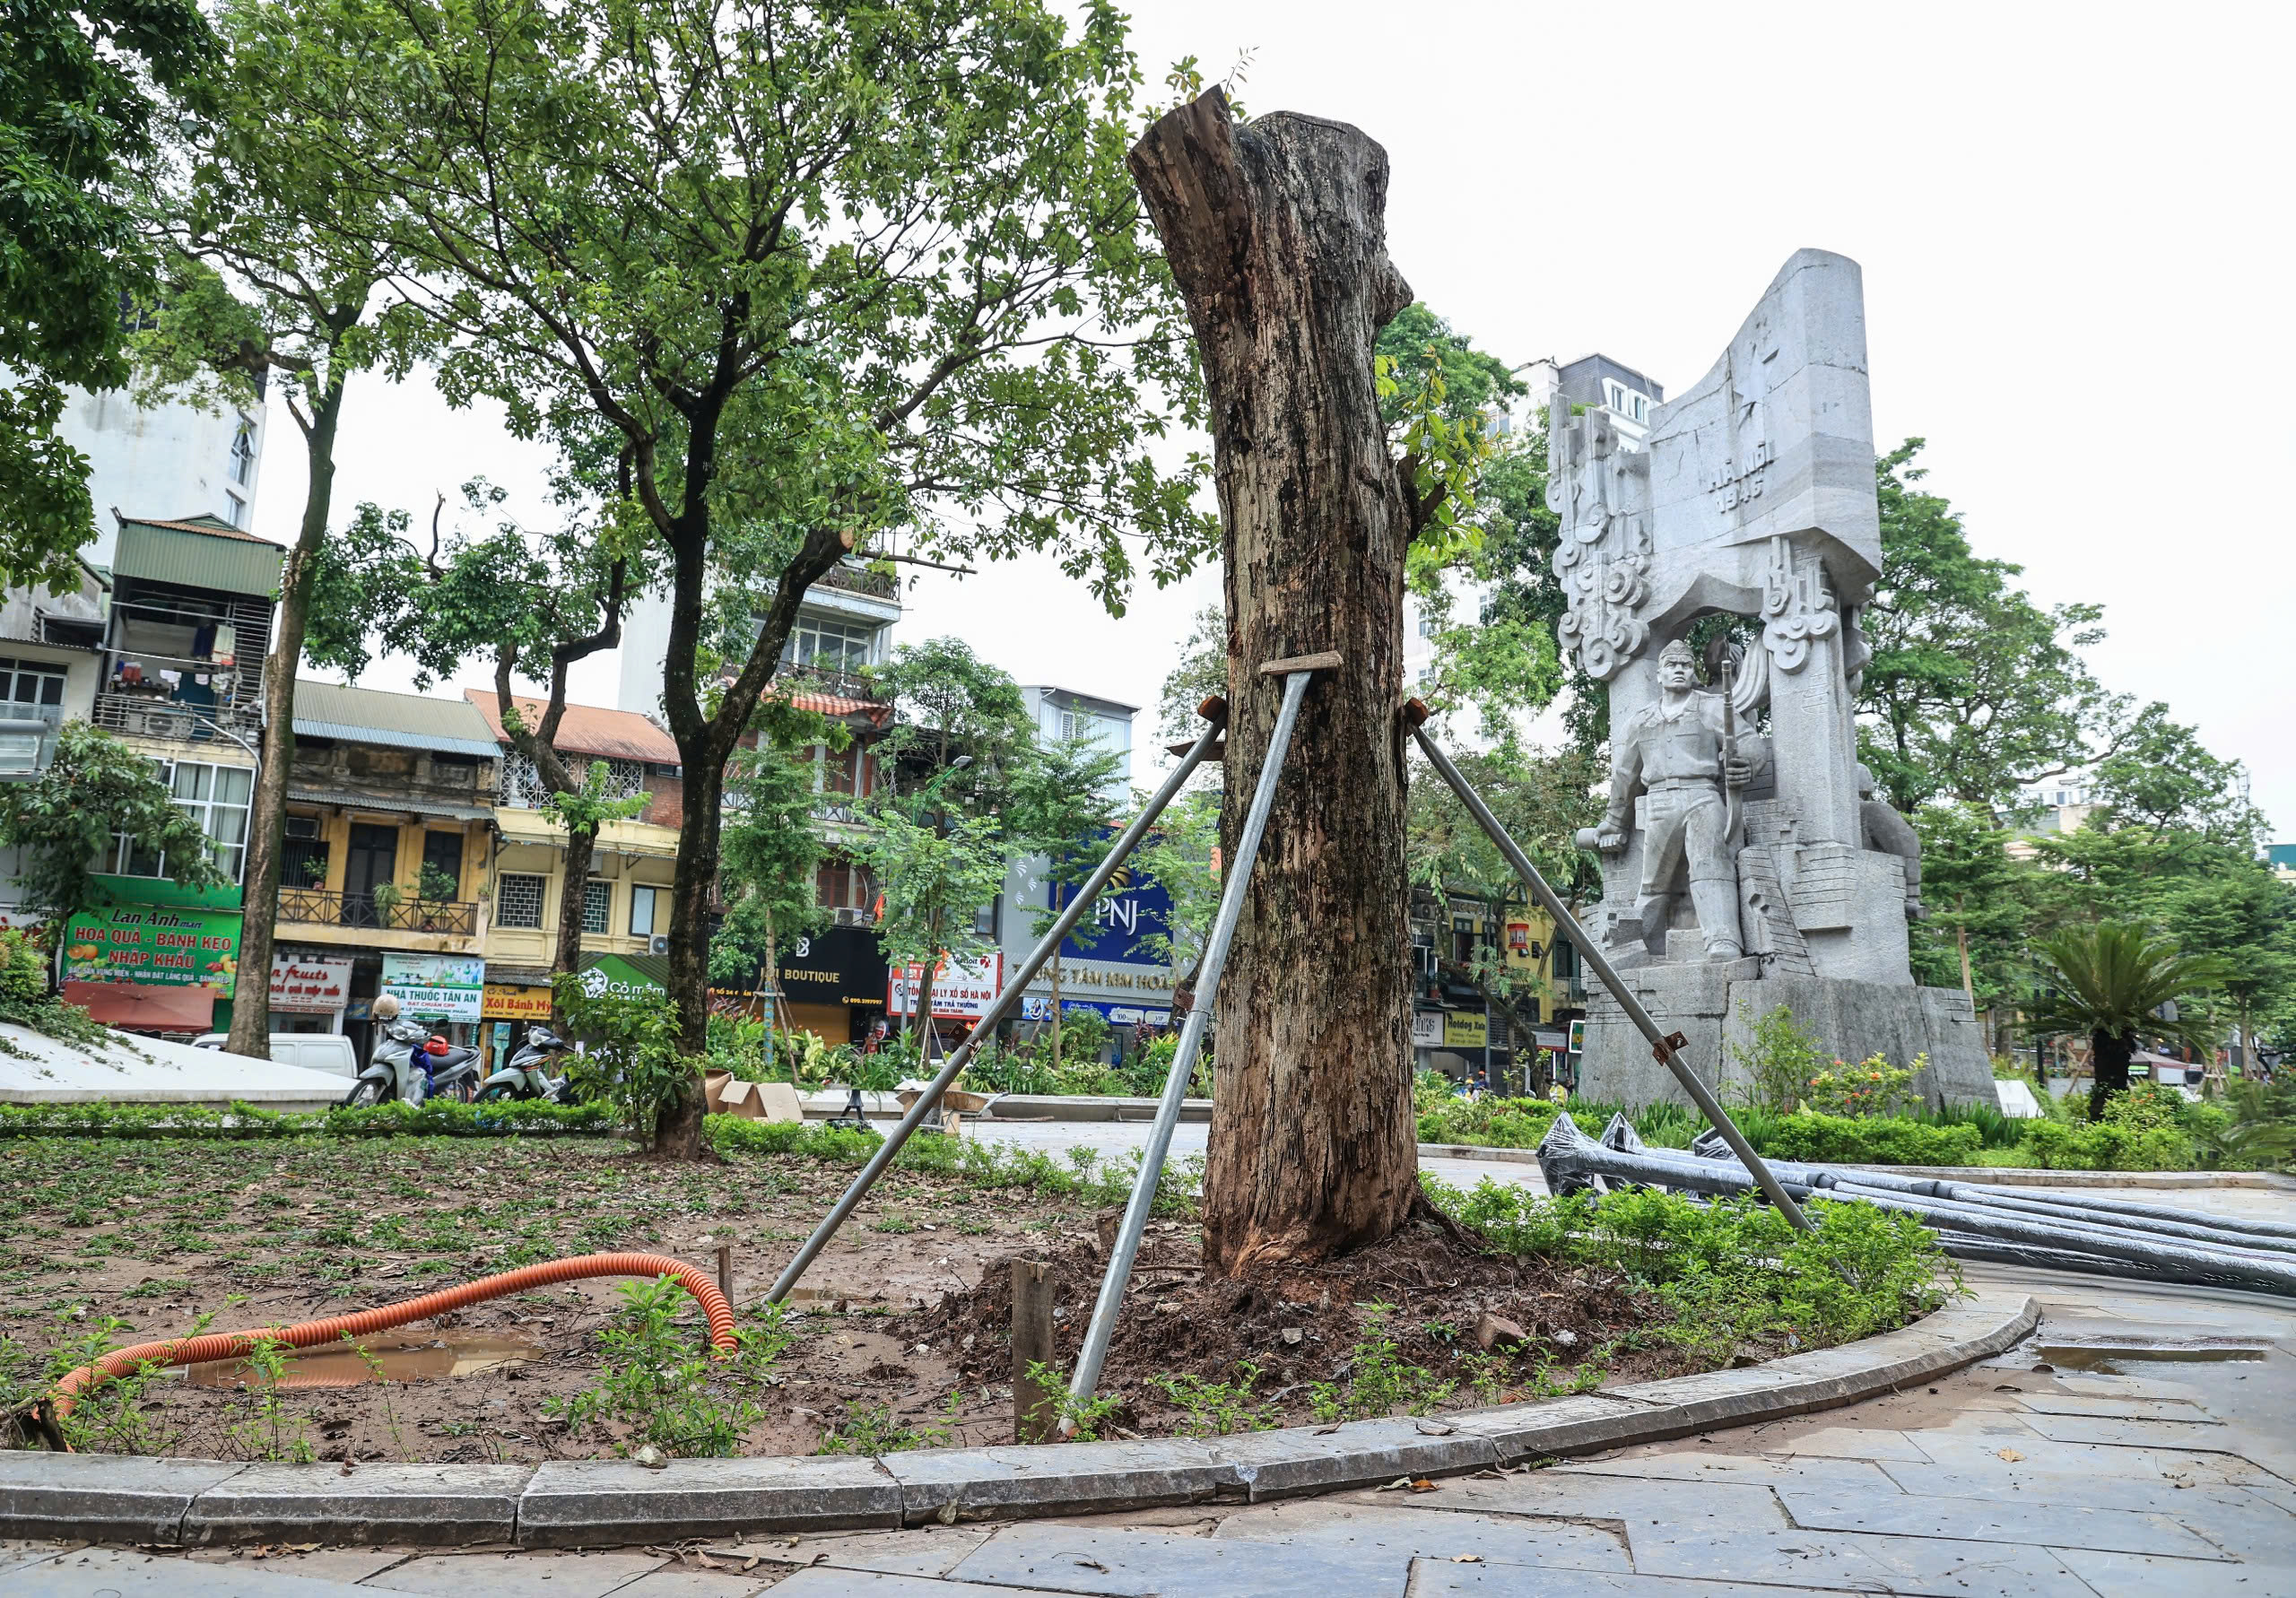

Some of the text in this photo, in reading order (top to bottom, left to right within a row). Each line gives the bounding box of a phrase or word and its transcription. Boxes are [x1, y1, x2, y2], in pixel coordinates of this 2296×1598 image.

[1708, 457, 1742, 493] HÀ
[1715, 477, 1764, 515] 1946
[111, 908, 203, 929] Lan Anh mart
[1094, 897, 1140, 936] PNJ
[75, 926, 106, 942] HOA
[111, 926, 141, 944] QUẢ
[156, 931, 196, 948] BÁNH
[201, 936, 231, 952] KẸO
[109, 949, 196, 968] NHẬP KHẨU
[784, 968, 840, 984] BOUTIQUE
[409, 988, 439, 1002] THUỐC
[463, 994, 477, 1003] AN
[609, 980, 630, 994] Cỏ
[950, 986, 958, 998] XỔ
[960, 986, 969, 999] SỐ
[970, 990, 979, 1000] HÀ
[980, 991, 991, 1002] NỘI
[485, 997, 504, 1008] Xôi
[508, 998, 533, 1010] Bánh
